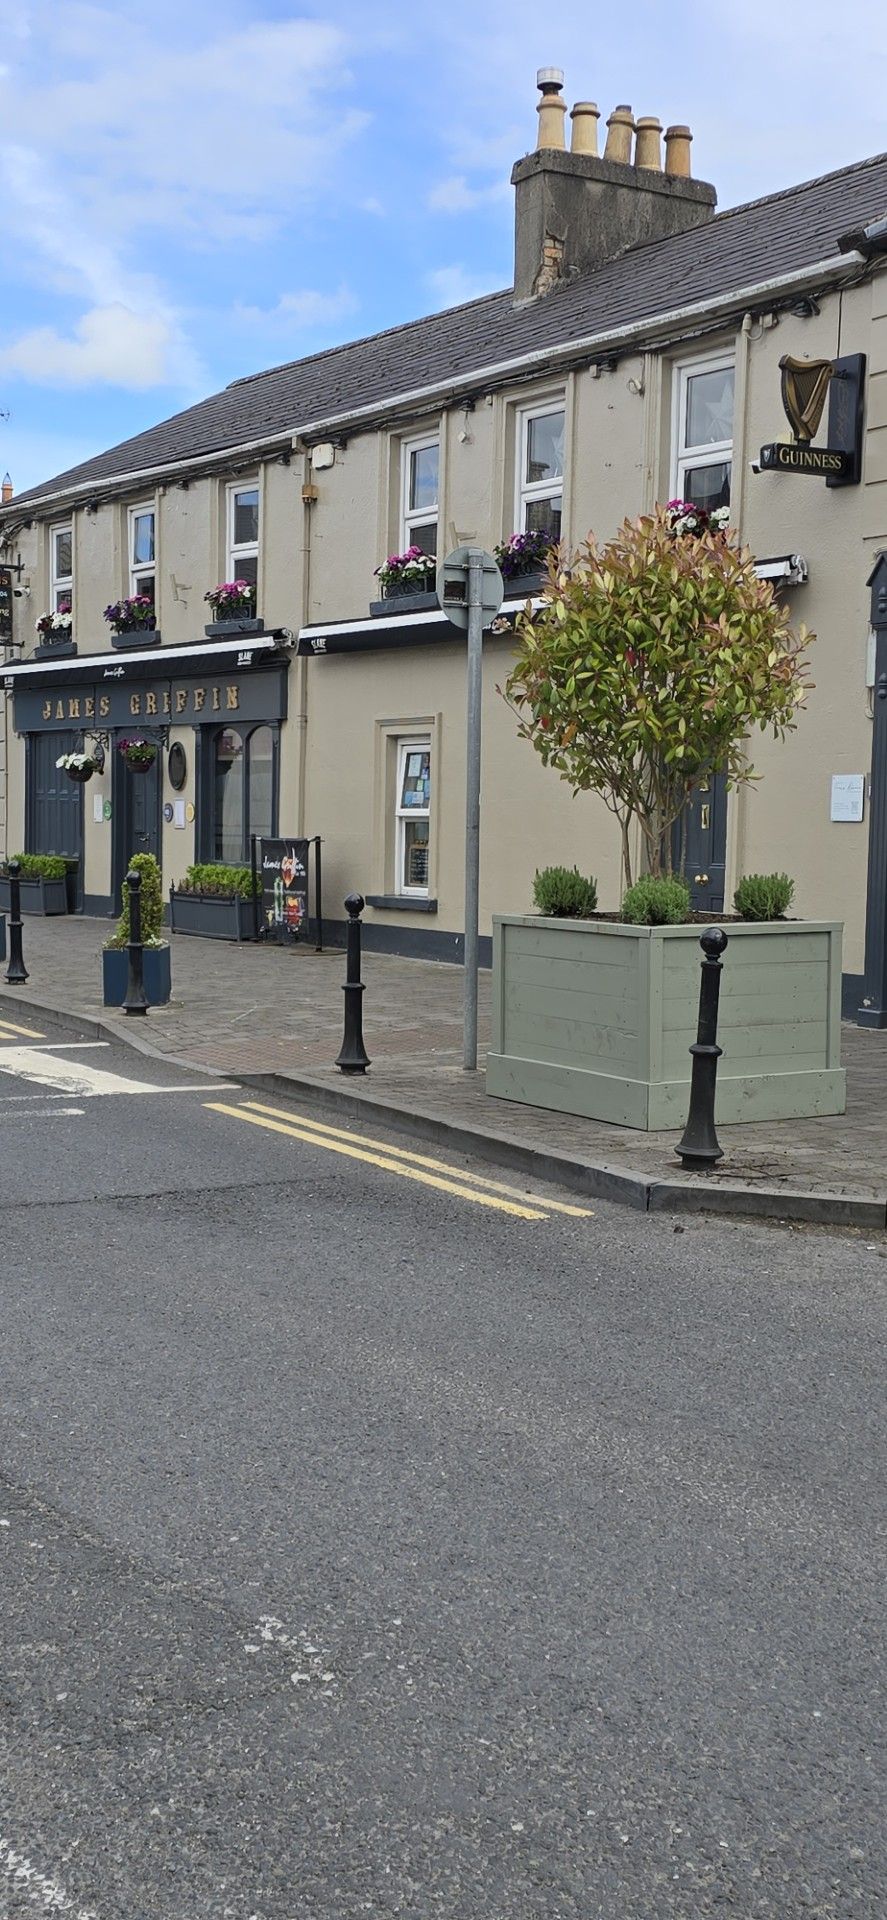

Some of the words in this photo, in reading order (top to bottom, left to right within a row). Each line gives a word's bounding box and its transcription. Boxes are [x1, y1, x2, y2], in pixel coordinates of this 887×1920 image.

[779, 447, 842, 469] GUINNESS
[42, 696, 111, 721] JAMES
[129, 686, 240, 715] GRIFFIN
